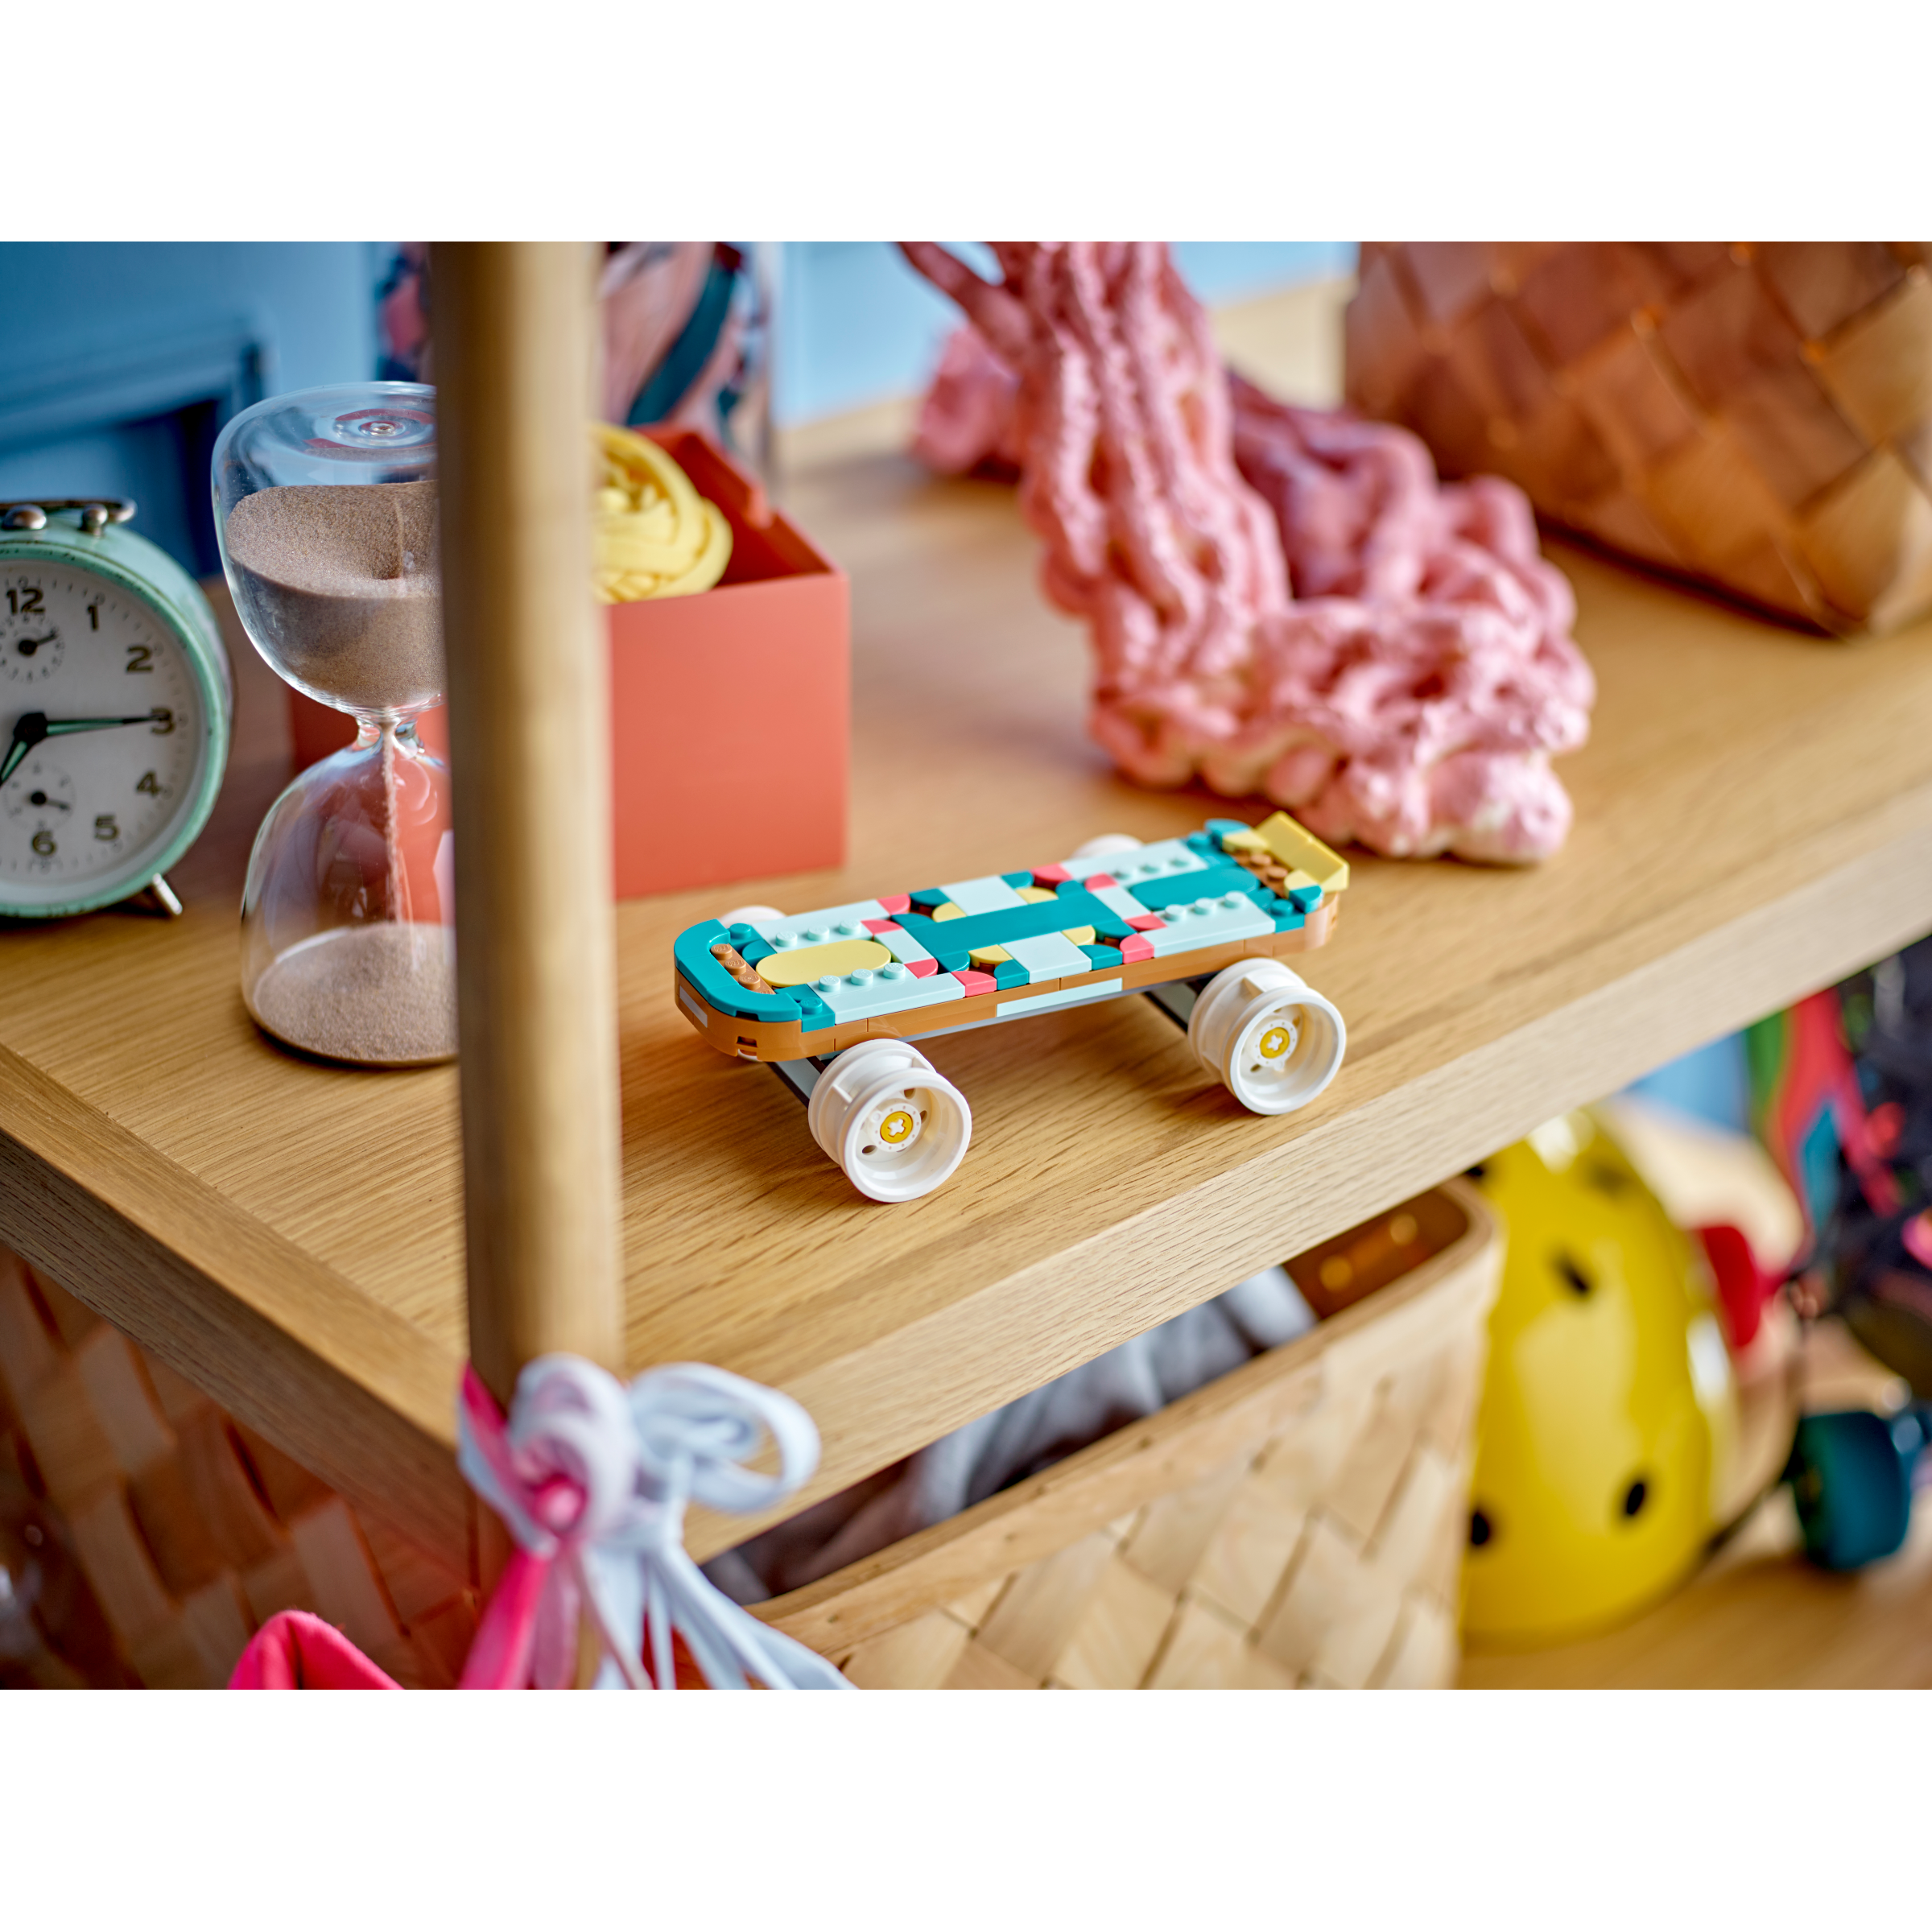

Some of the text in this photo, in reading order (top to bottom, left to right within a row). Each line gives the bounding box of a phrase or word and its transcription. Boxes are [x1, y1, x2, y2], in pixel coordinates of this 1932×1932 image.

[6, 588, 45, 615] 12
[87, 604, 99, 631] 1
[126, 645, 154, 673] 2
[149, 707, 175, 735] 3
[136, 770, 161, 796] 4
[95, 815, 119, 841] 5
[31, 830, 56, 857] 6
